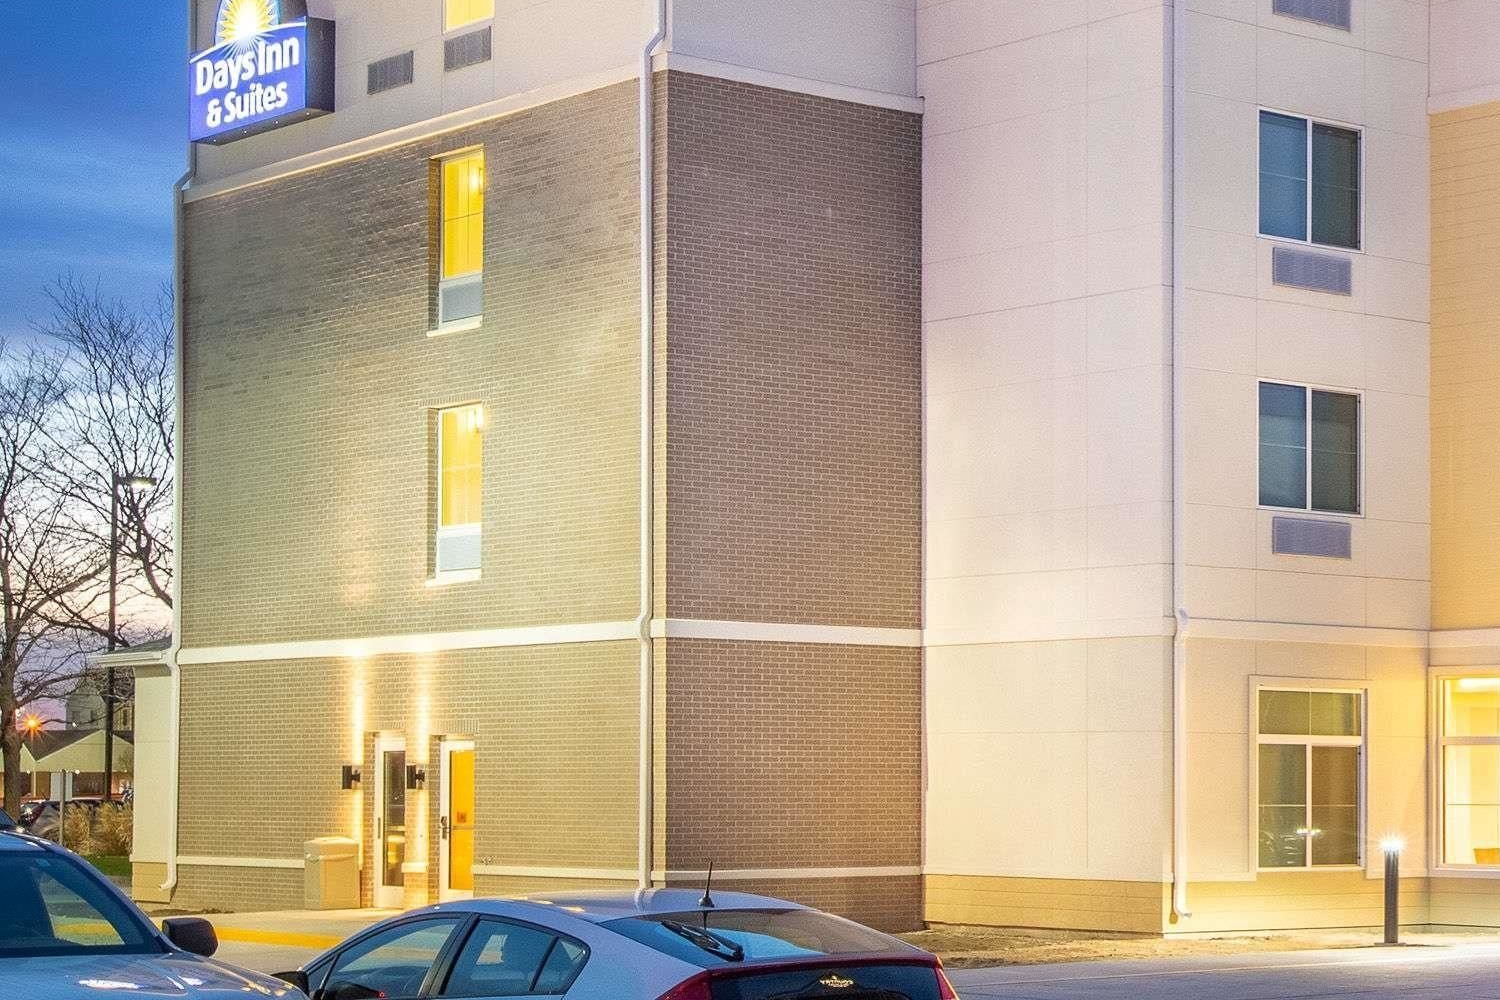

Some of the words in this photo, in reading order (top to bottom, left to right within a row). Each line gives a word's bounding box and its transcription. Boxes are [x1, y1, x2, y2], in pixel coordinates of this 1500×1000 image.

[196, 51, 255, 95] Days
[258, 37, 299, 75] Inn
[206, 98, 222, 128] &
[224, 82, 288, 122] Suites
